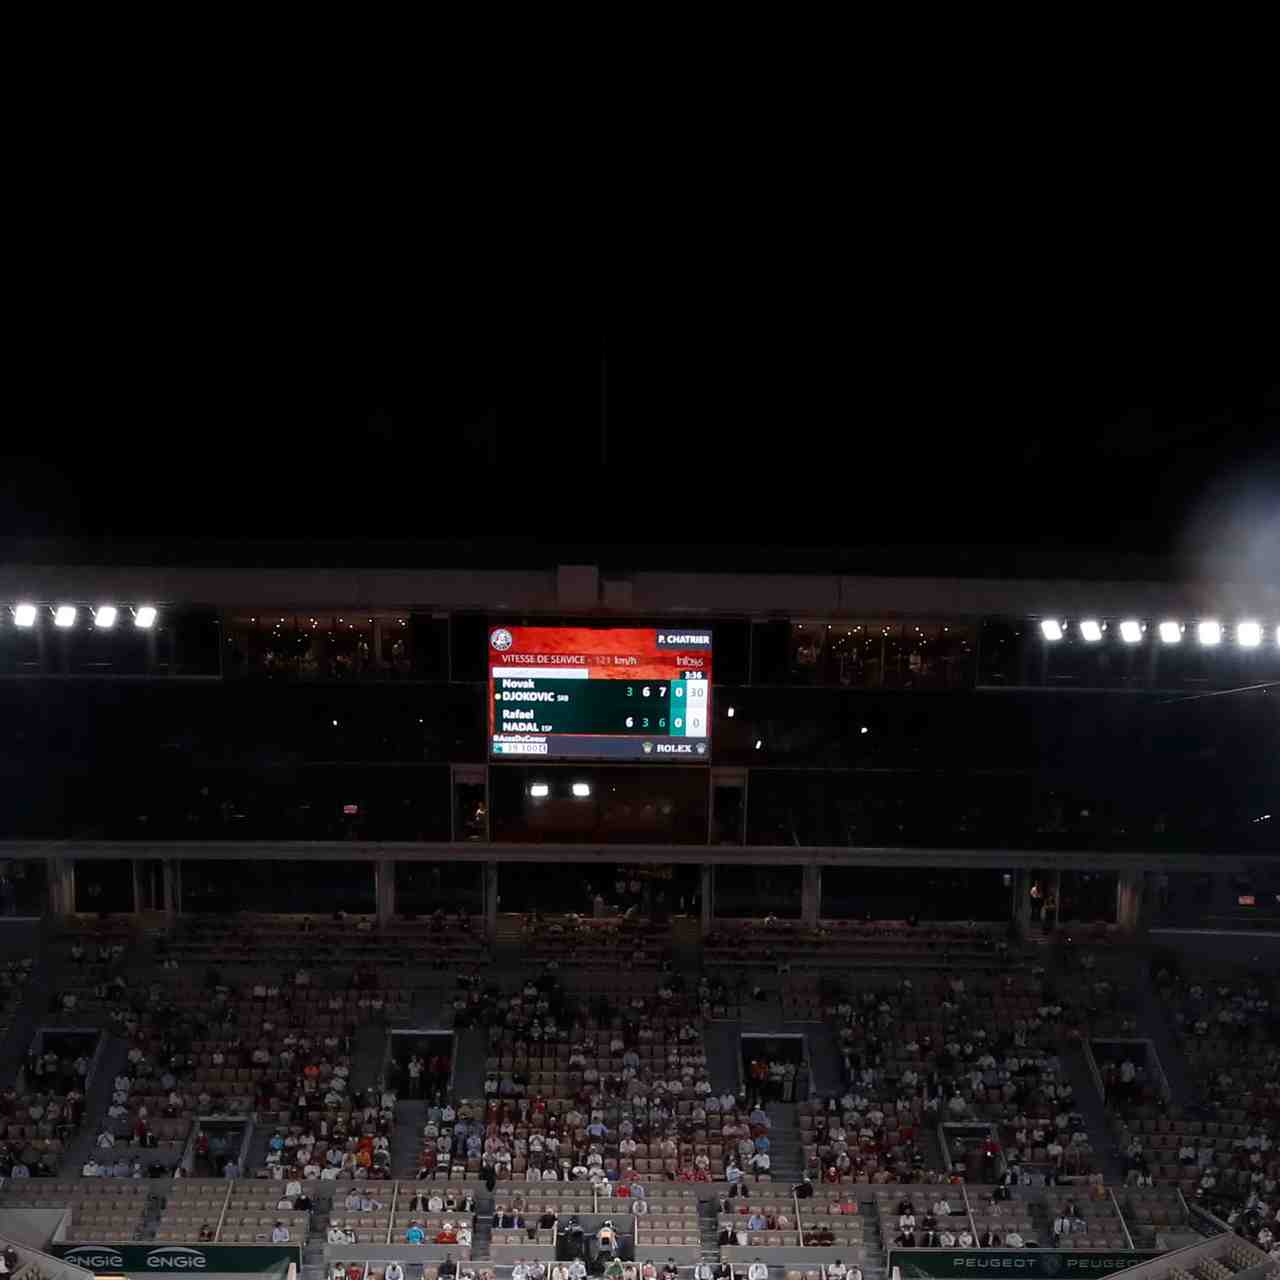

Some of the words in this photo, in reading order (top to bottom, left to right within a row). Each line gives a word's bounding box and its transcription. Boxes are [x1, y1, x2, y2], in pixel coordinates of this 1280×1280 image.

[666, 635, 710, 644] CHATRIER
[502, 654, 534, 664] VITESSE
[551, 655, 585, 664] SERVICE
[502, 679, 535, 688] Novak
[502, 692, 555, 701] DJOKOVIC
[625, 687, 633, 697] 3
[642, 687, 651, 697] 6
[659, 687, 667, 697] 7
[675, 687, 683, 697] 0
[690, 688, 704, 697] 30
[502, 709, 534, 719] Rafael
[625, 717, 634, 727] 6
[642, 718, 649, 727] 3
[659, 718, 666, 727] 6
[674, 718, 683, 727] 0
[693, 718, 700, 727] 0
[502, 722, 539, 732] NADAL
[657, 744, 692, 752] ROLEX
[953, 1258, 1037, 1267] PEUGEOT
